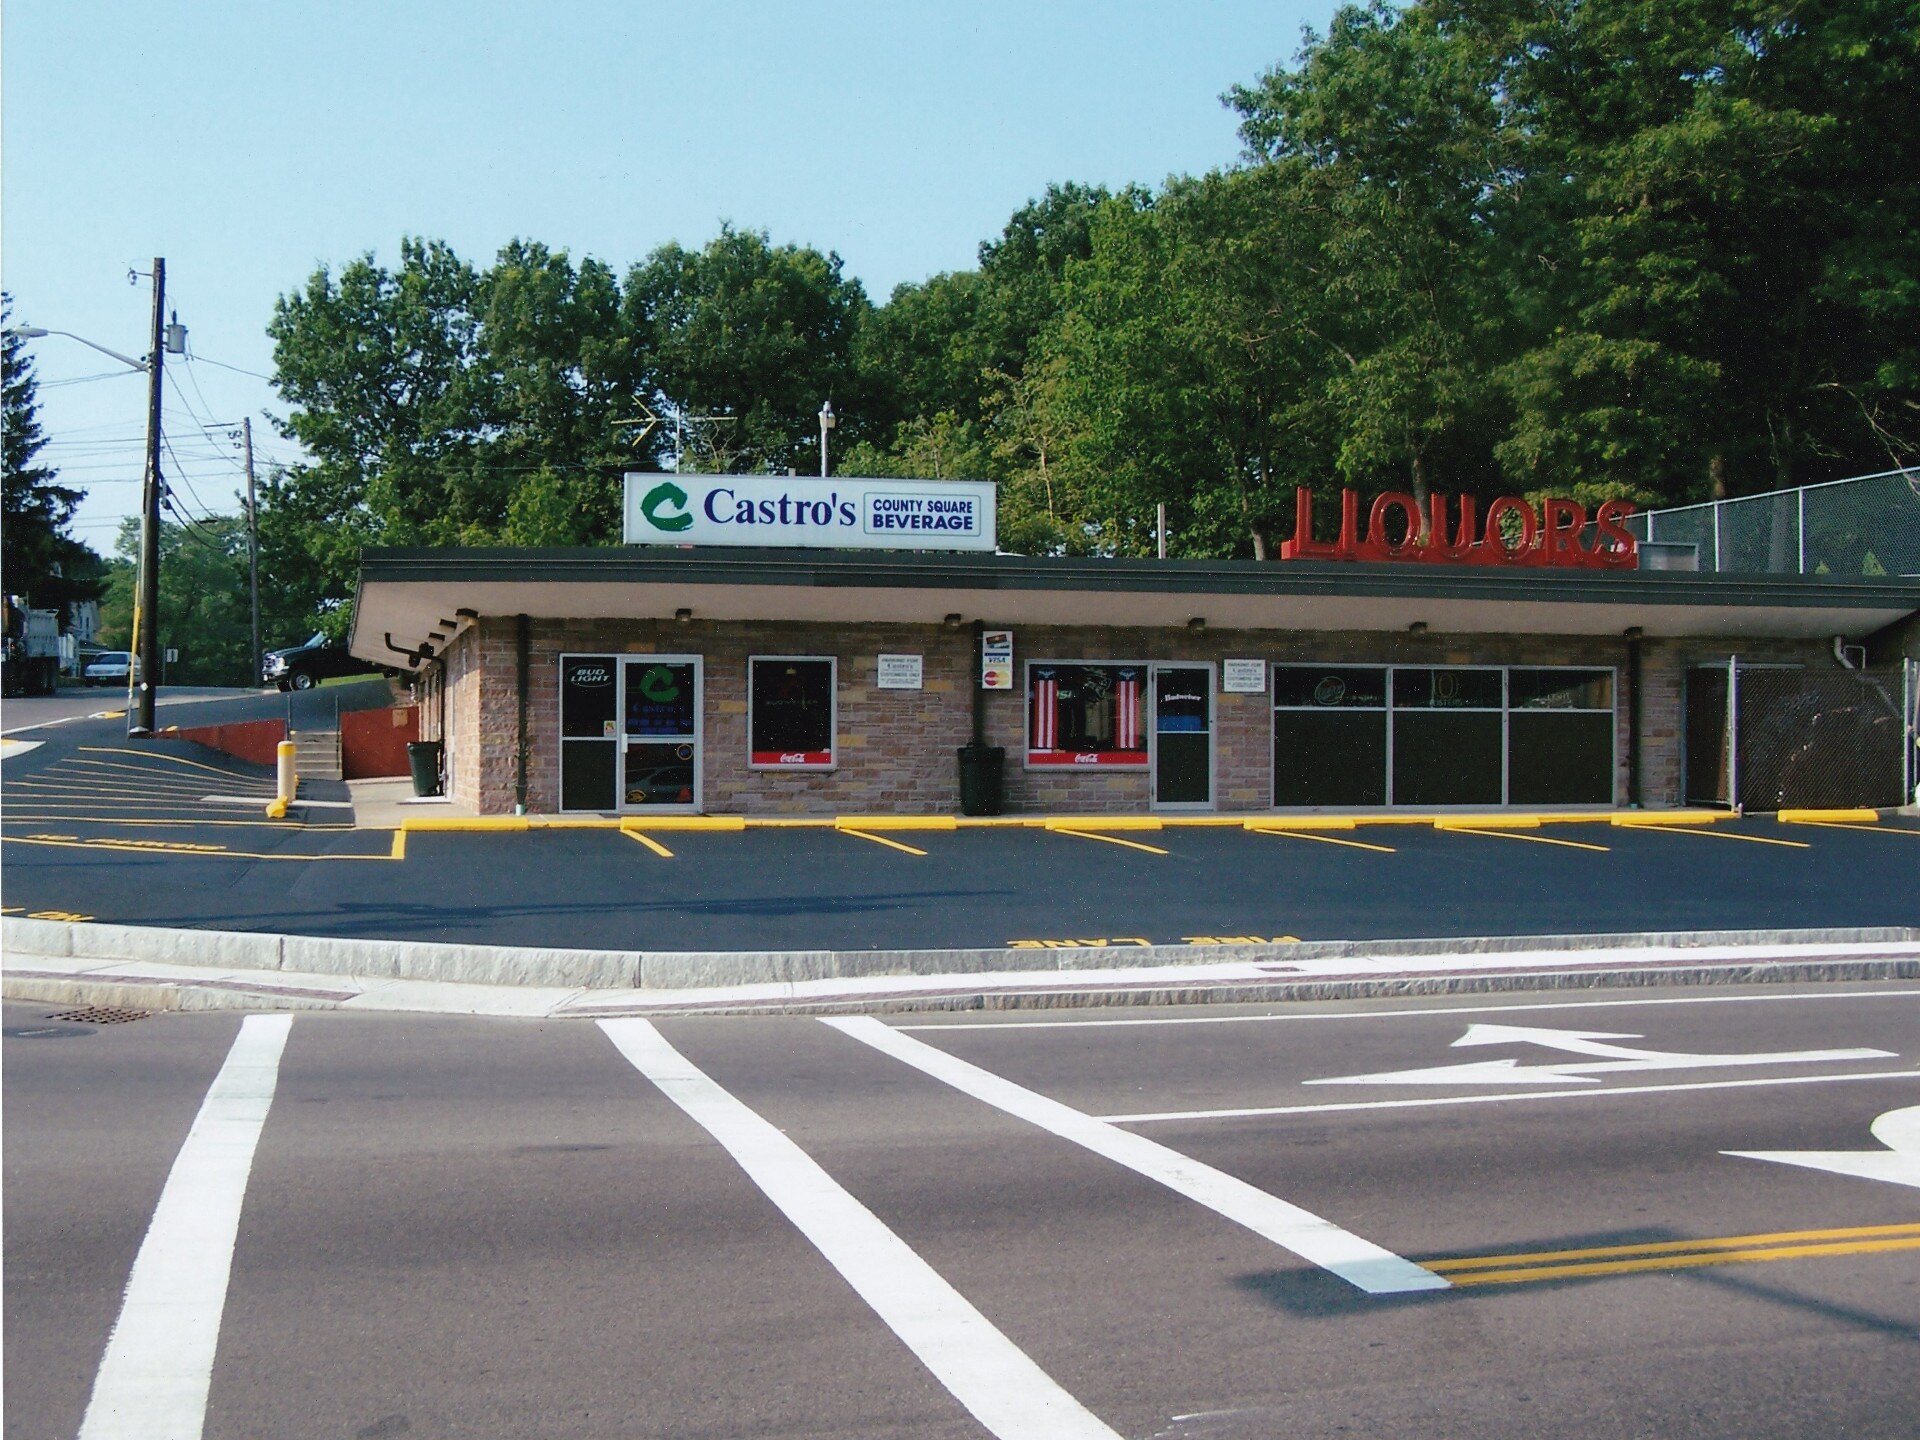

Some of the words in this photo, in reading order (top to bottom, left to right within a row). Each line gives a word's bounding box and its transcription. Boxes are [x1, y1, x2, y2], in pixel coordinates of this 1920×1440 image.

[703, 488, 856, 527] Castro's
[873, 498, 923, 513] COUNTY
[927, 499, 973, 514] SQUARE
[872, 514, 974, 530] BEVERAGE
[1296, 486, 1637, 564] LIQUORS
[576, 668, 606, 676] BUD
